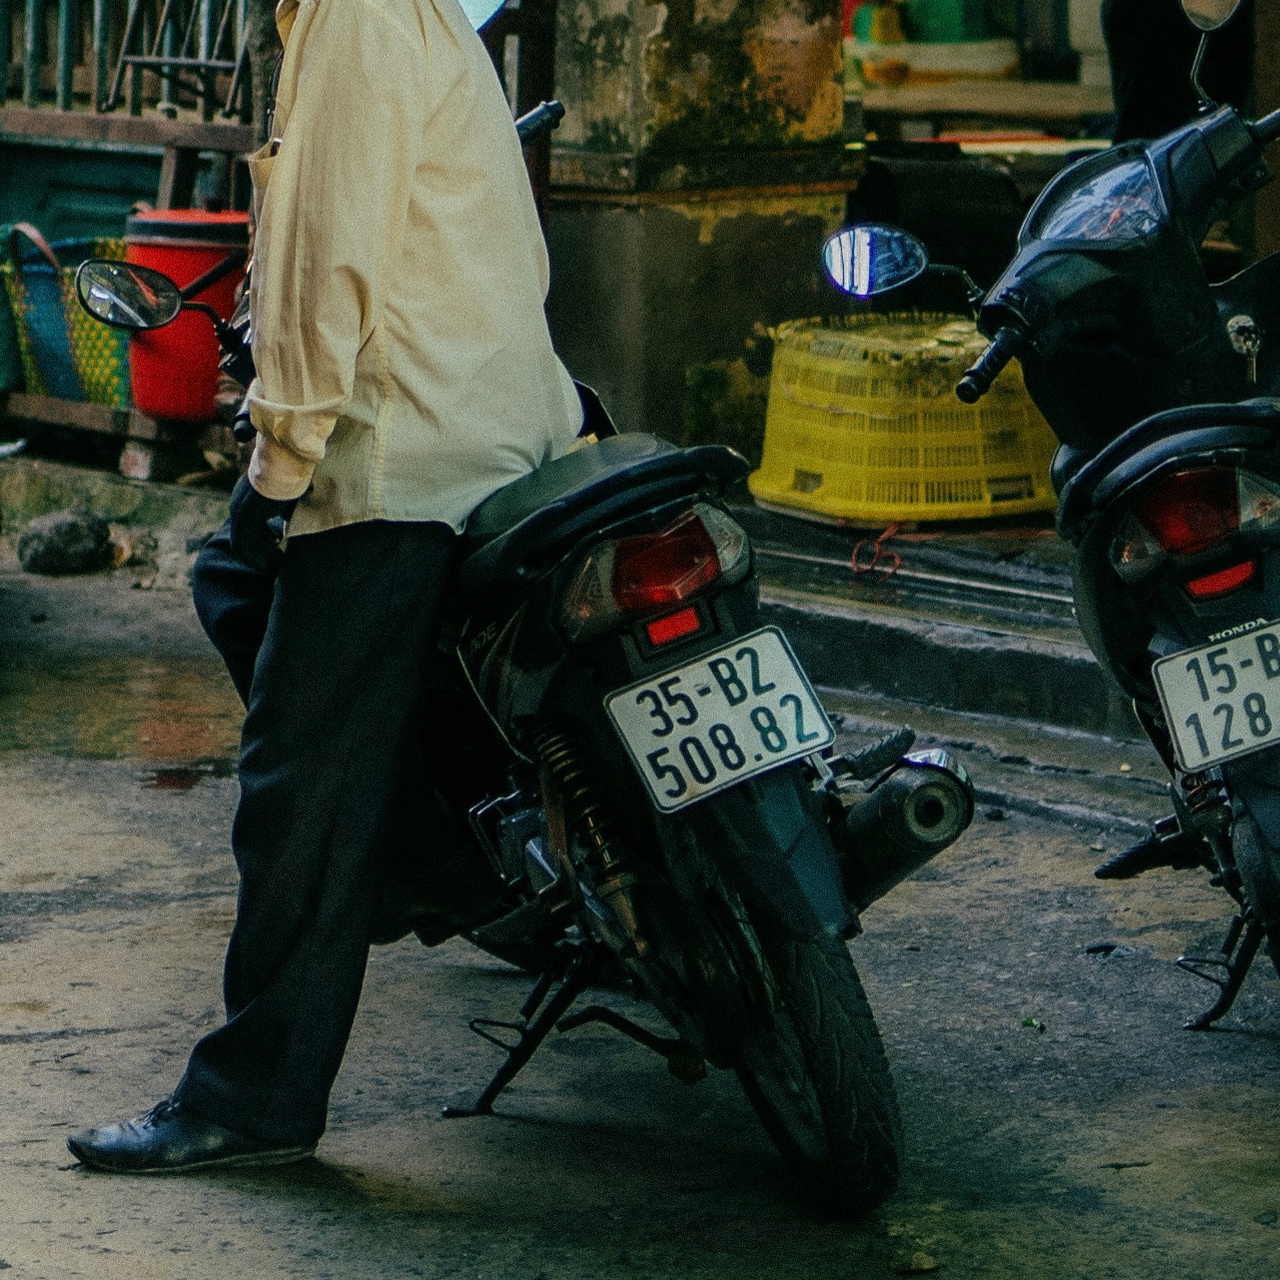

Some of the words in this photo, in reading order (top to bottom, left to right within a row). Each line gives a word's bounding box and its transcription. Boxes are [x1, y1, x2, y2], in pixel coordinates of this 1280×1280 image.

[1207, 617, 1269, 643] HONDA
[635, 647, 776, 738] 35-B2
[646, 693, 819, 799] 508.82
